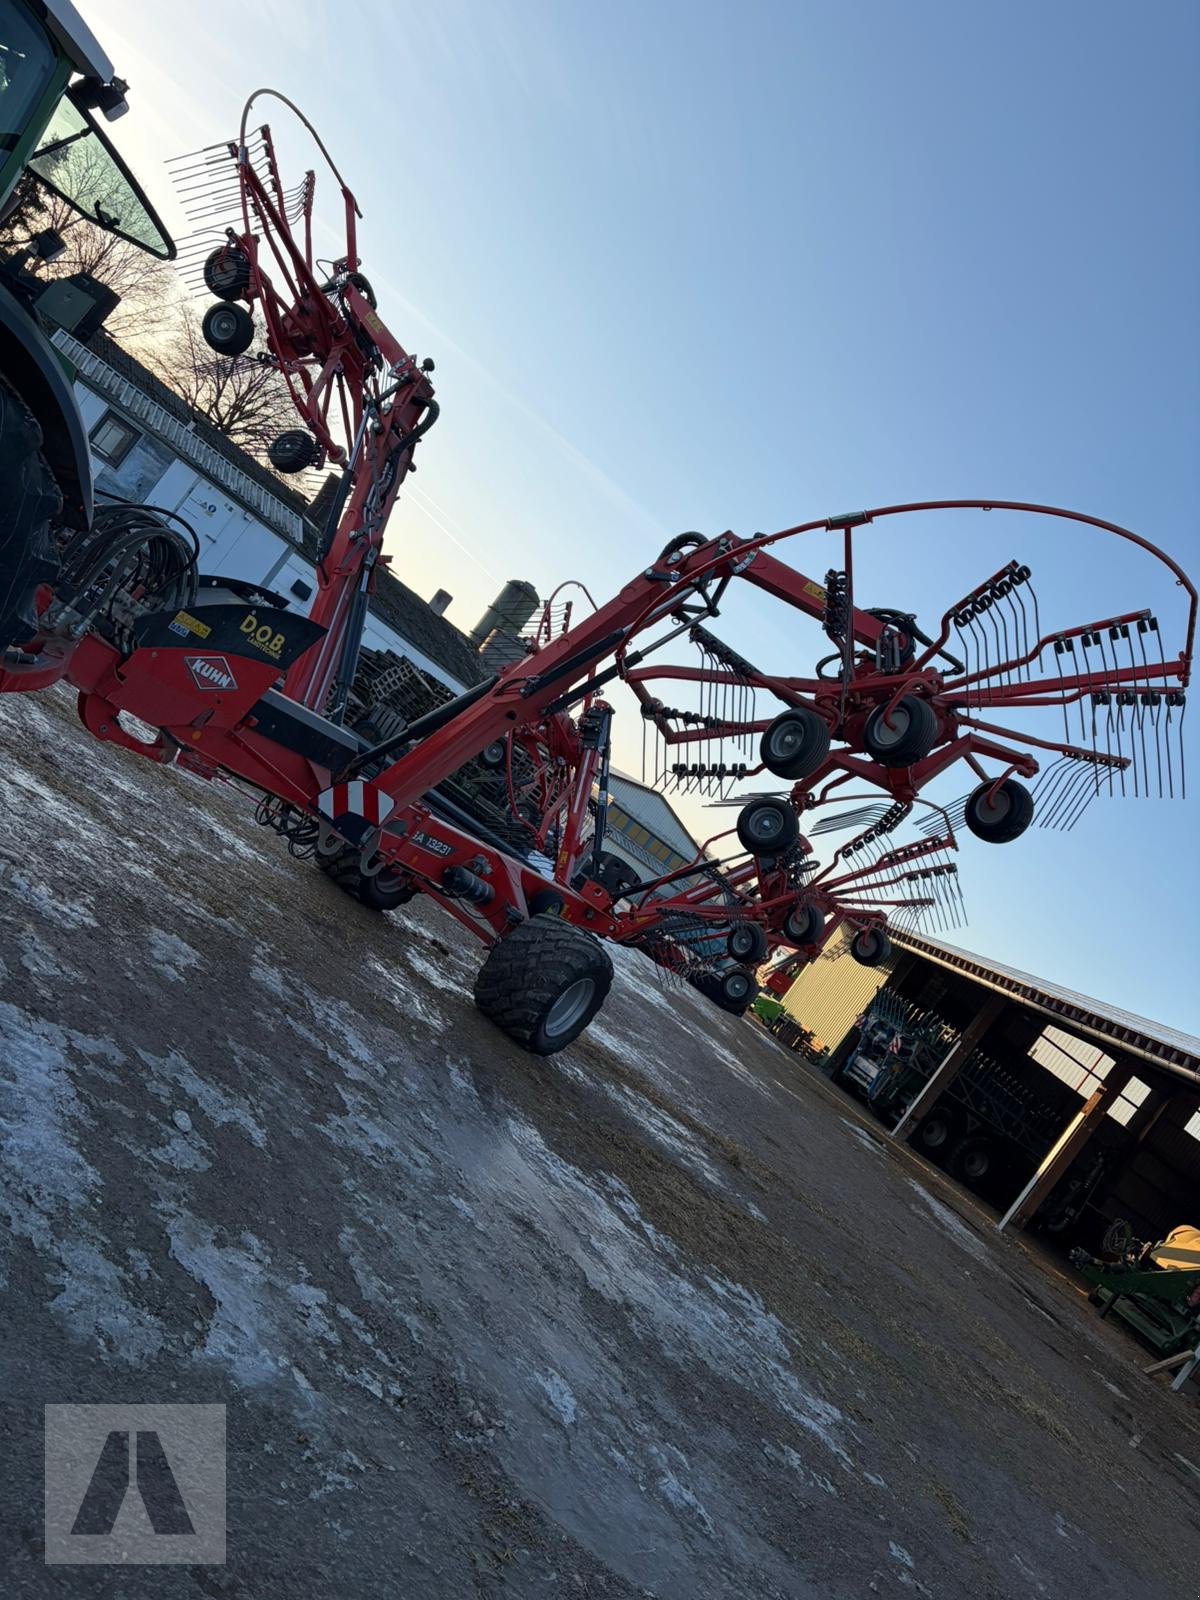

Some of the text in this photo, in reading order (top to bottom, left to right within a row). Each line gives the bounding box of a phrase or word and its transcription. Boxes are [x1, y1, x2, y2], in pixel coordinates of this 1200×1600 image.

[240, 615, 285, 653] D.O.B.
[192, 659, 231, 688] KUHN
[426, 838, 451, 855] 13231
